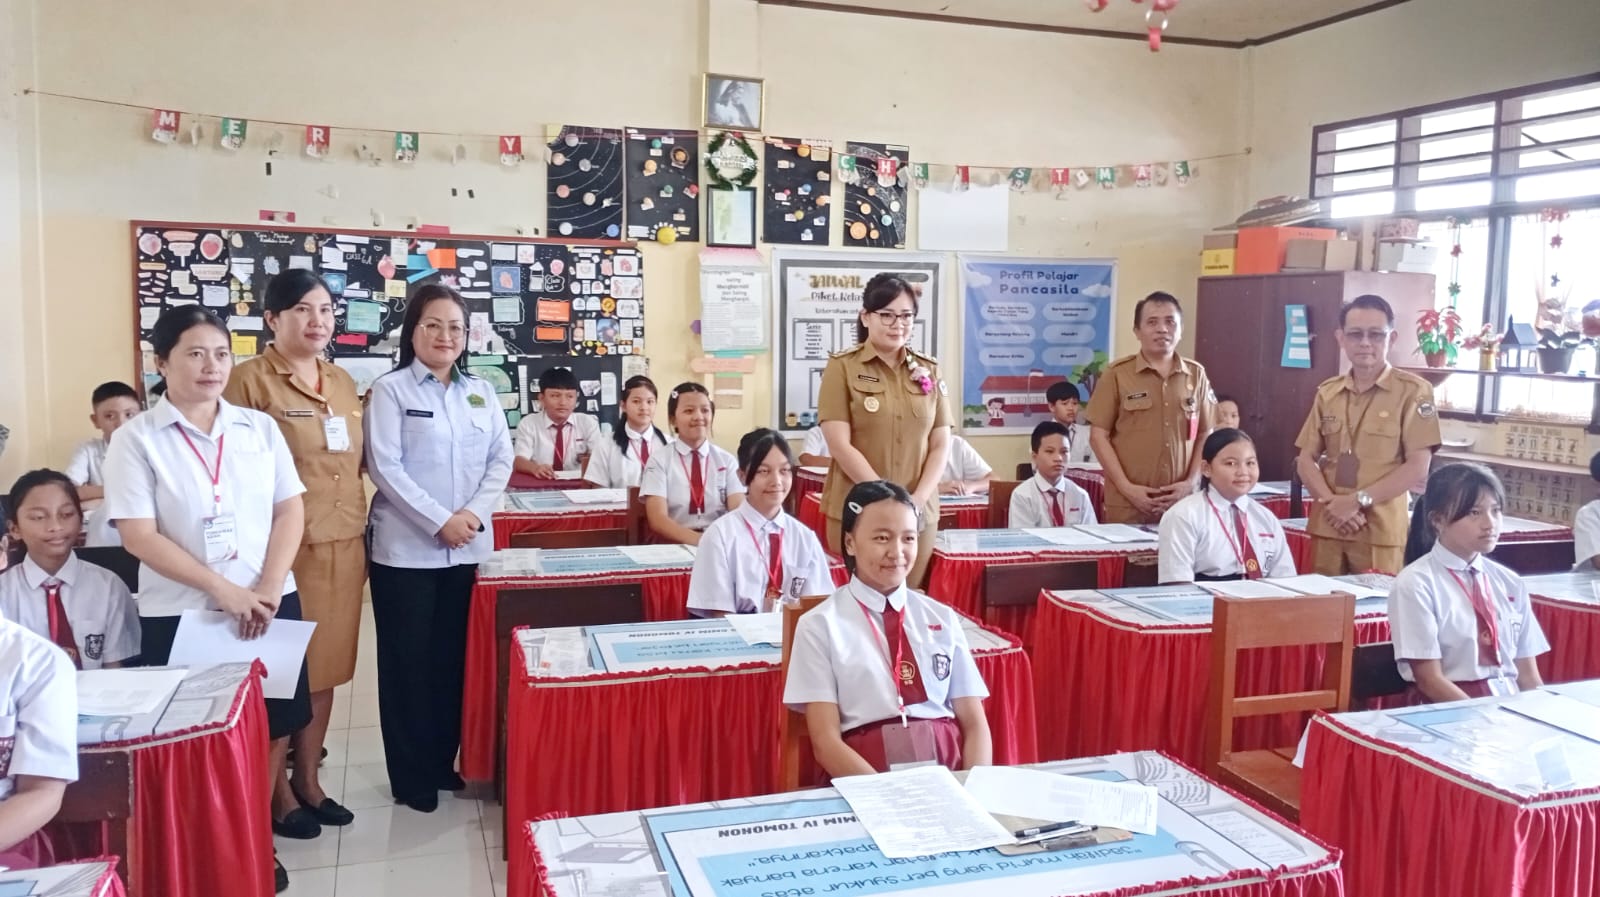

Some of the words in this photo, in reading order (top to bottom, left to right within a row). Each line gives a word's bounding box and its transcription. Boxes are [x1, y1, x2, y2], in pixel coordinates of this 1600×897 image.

[999, 270, 1034, 281] Profil
[1037, 270, 1080, 283] Pelajar
[999, 283, 1080, 295] Pancasila
[802, 819, 819, 829] IV
[822, 814, 858, 827] MIM
[717, 822, 800, 839] TOMOHON
[801, 860, 878, 877] karena
[942, 862, 993, 878] yang
[998, 853, 1062, 872] murid
[719, 869, 797, 889] banyak
